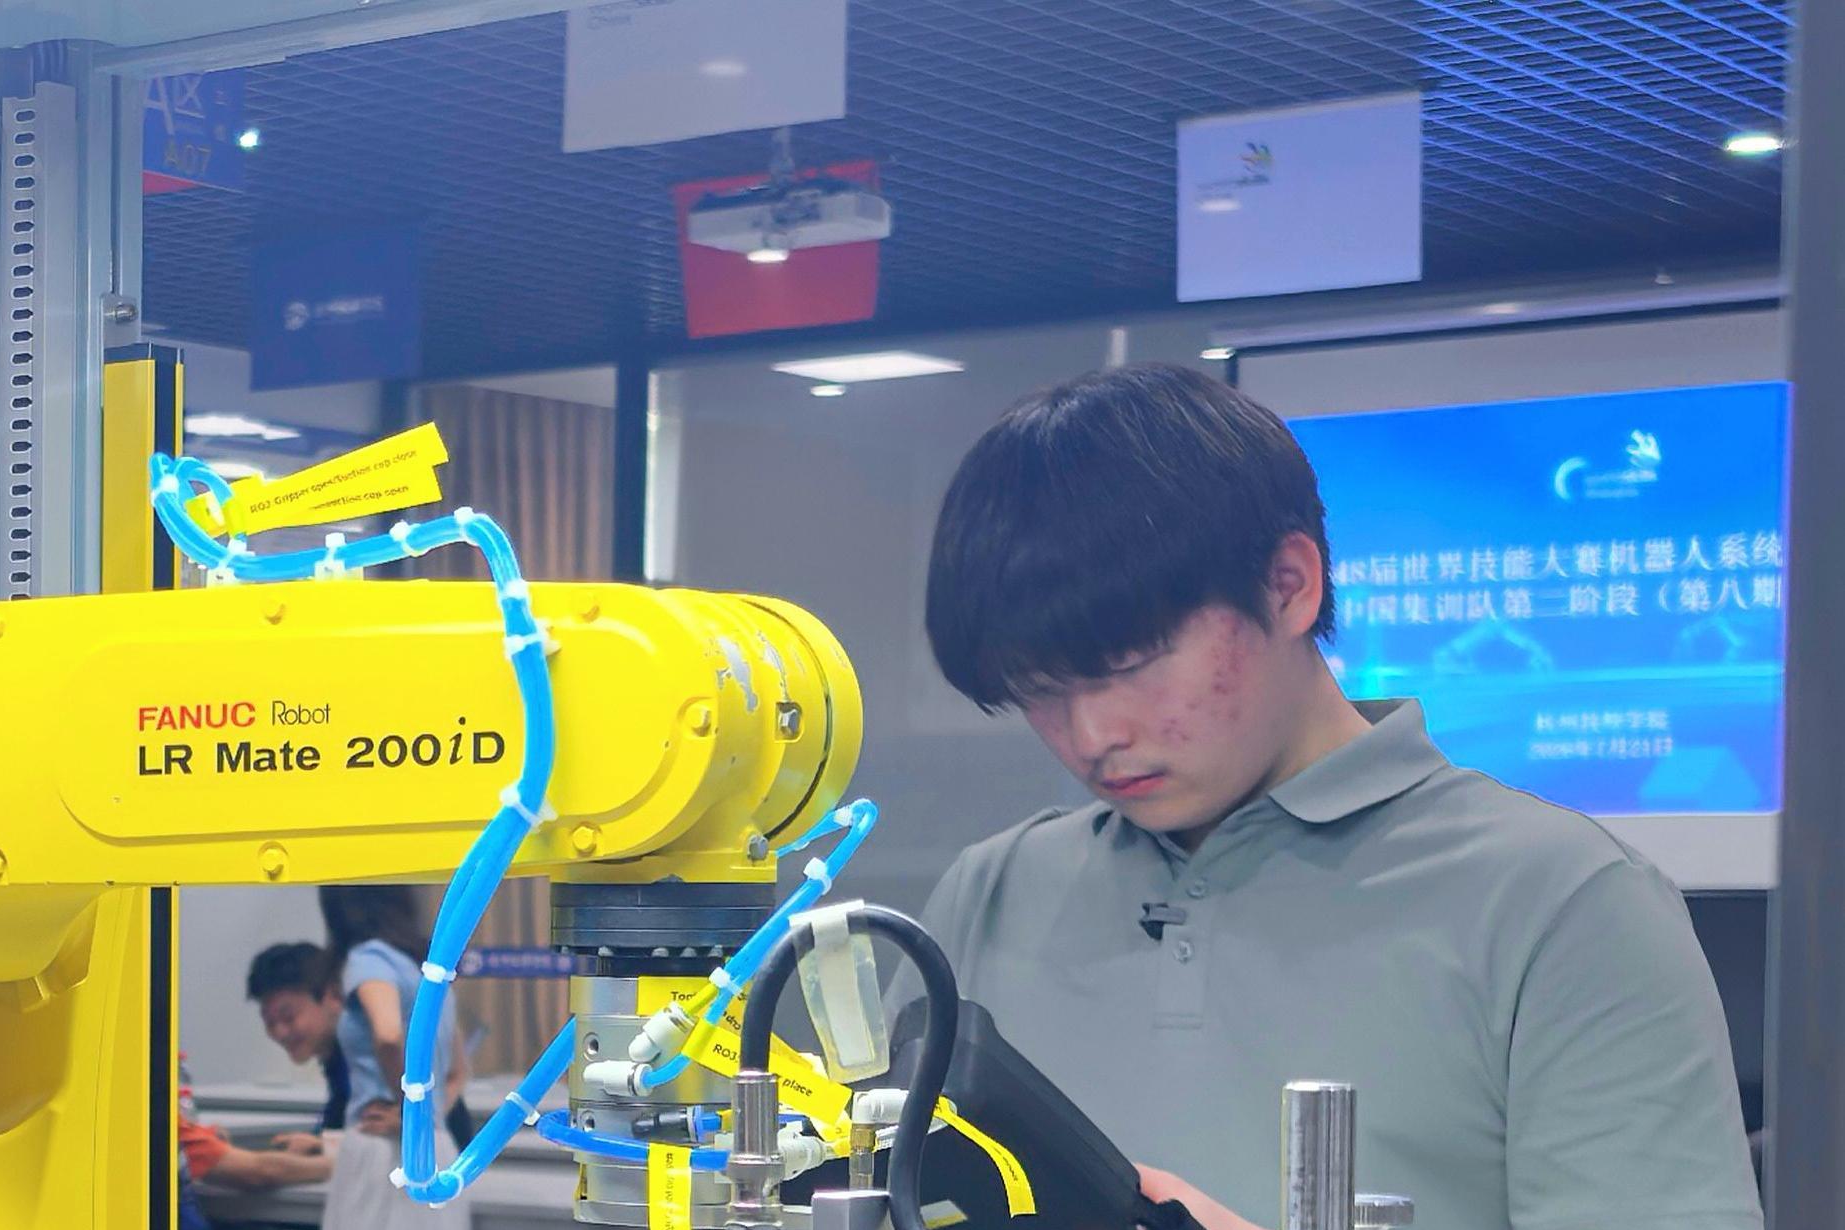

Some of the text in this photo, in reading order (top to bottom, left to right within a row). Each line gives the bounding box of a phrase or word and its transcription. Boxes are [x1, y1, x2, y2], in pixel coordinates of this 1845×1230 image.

[138, 700, 331, 731] FANUC Robot
[138, 716, 505, 776] LR Mate 200iD
[781, 1073, 814, 1097] place
